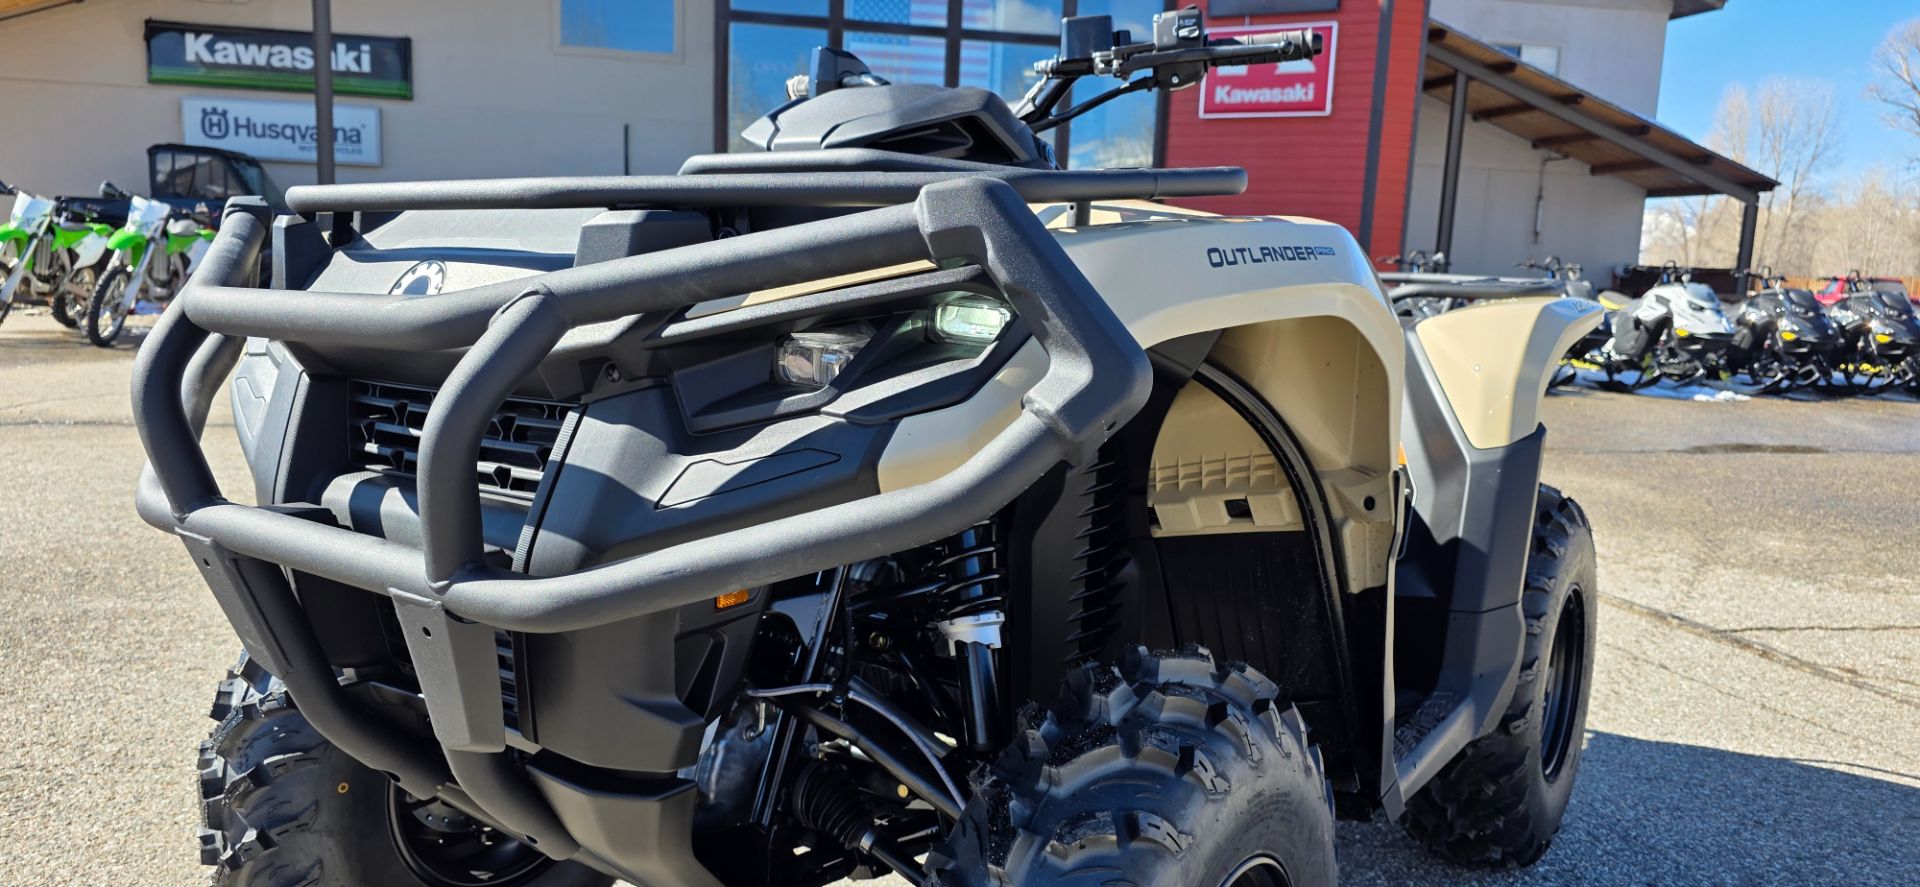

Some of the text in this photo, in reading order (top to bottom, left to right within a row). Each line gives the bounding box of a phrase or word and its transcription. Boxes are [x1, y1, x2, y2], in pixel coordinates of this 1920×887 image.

[184, 32, 371, 73] Kawaski
[1214, 82, 1314, 104] Kawasaki
[234, 117, 361, 145] Husqvana
[1207, 246, 1318, 268] OUTLANDER
